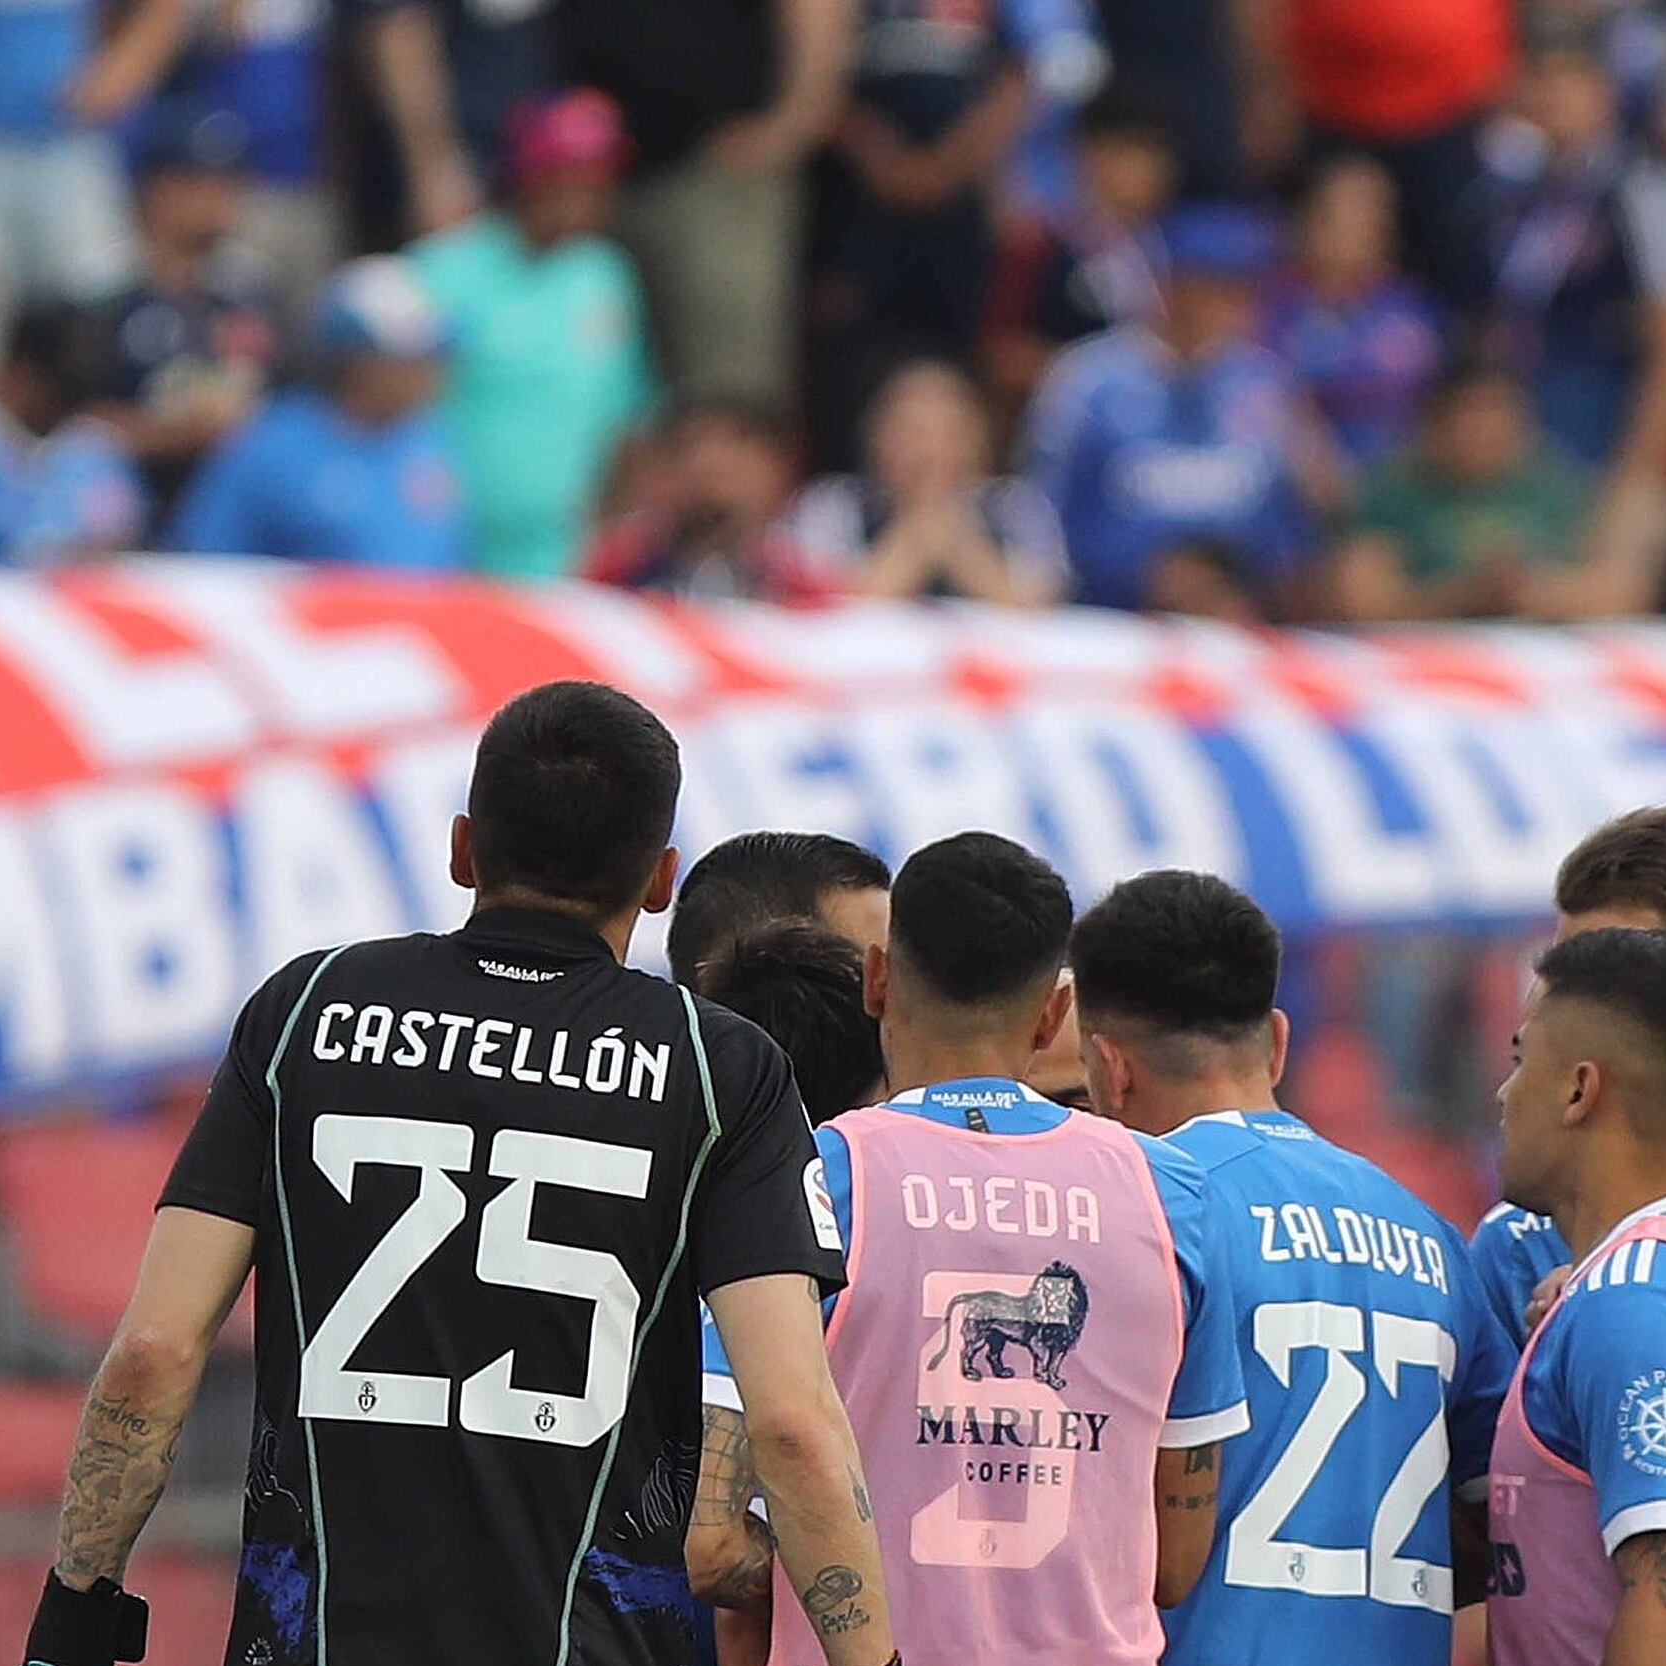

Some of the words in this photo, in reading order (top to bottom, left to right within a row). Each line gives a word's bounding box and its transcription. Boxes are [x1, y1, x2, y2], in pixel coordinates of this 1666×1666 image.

[313, 1002, 671, 1102] CASTELLÓN
[901, 1174, 1100, 1243] OJEDA
[1249, 1204, 1451, 1295] ZALDIVIA
[298, 1113, 653, 1447] 25
[916, 1404, 1111, 1452] MARLEY
[966, 1461, 1064, 1486] COFFEE
[1224, 1301, 1458, 1616] 22
